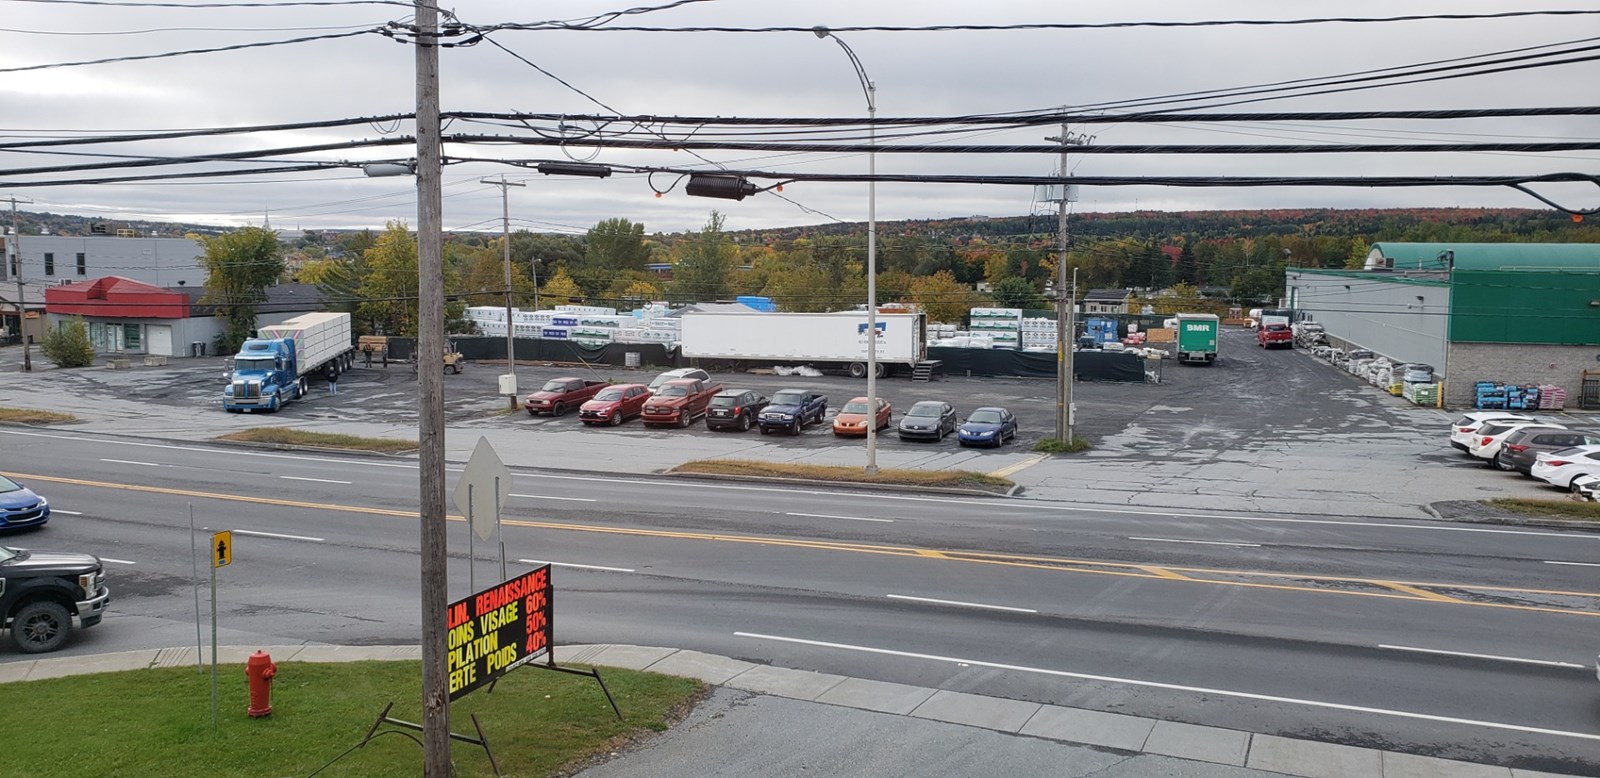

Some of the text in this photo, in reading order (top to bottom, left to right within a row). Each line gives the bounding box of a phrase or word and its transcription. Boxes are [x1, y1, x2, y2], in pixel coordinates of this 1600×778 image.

[448, 568, 547, 629] LIN. RENAISSANCE
[448, 590, 547, 650] OINS VISAGE 60%
[448, 631, 498, 673] PILATION
[526, 610, 547, 634] 50%
[449, 662, 477, 694] ERTE
[487, 642, 517, 675] POIDS
[526, 629, 547, 653] 40%
